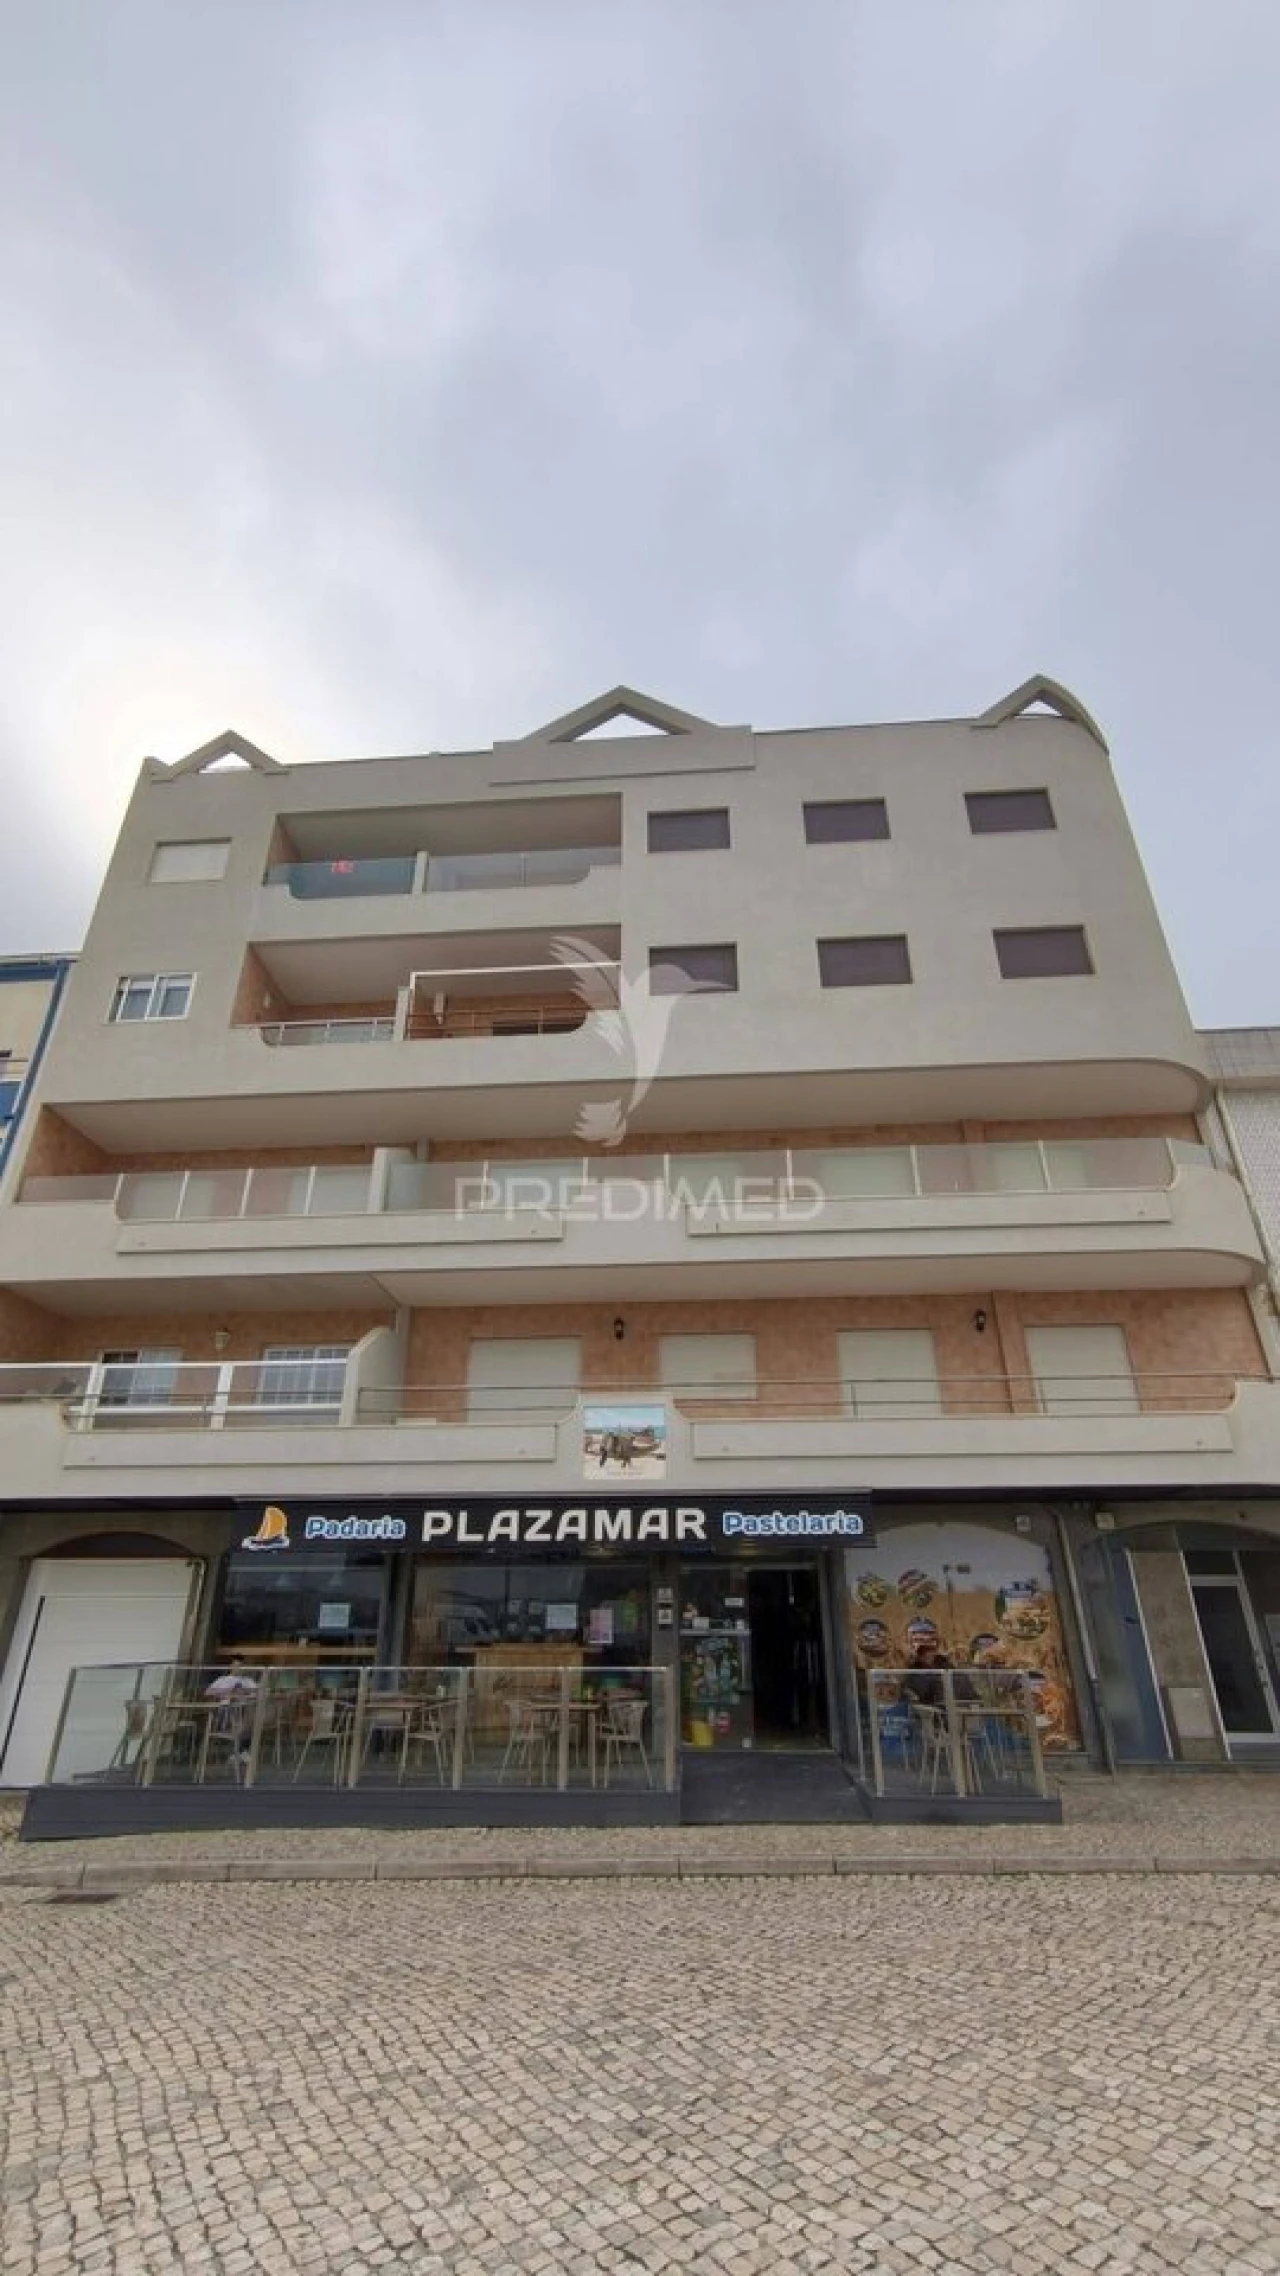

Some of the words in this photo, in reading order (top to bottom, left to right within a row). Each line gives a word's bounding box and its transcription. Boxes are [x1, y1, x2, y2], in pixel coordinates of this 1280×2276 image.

[304, 1515, 406, 1540] Padaria
[421, 1508, 707, 1543] PLAZAMAR
[721, 1510, 864, 1536] Pastelaria
